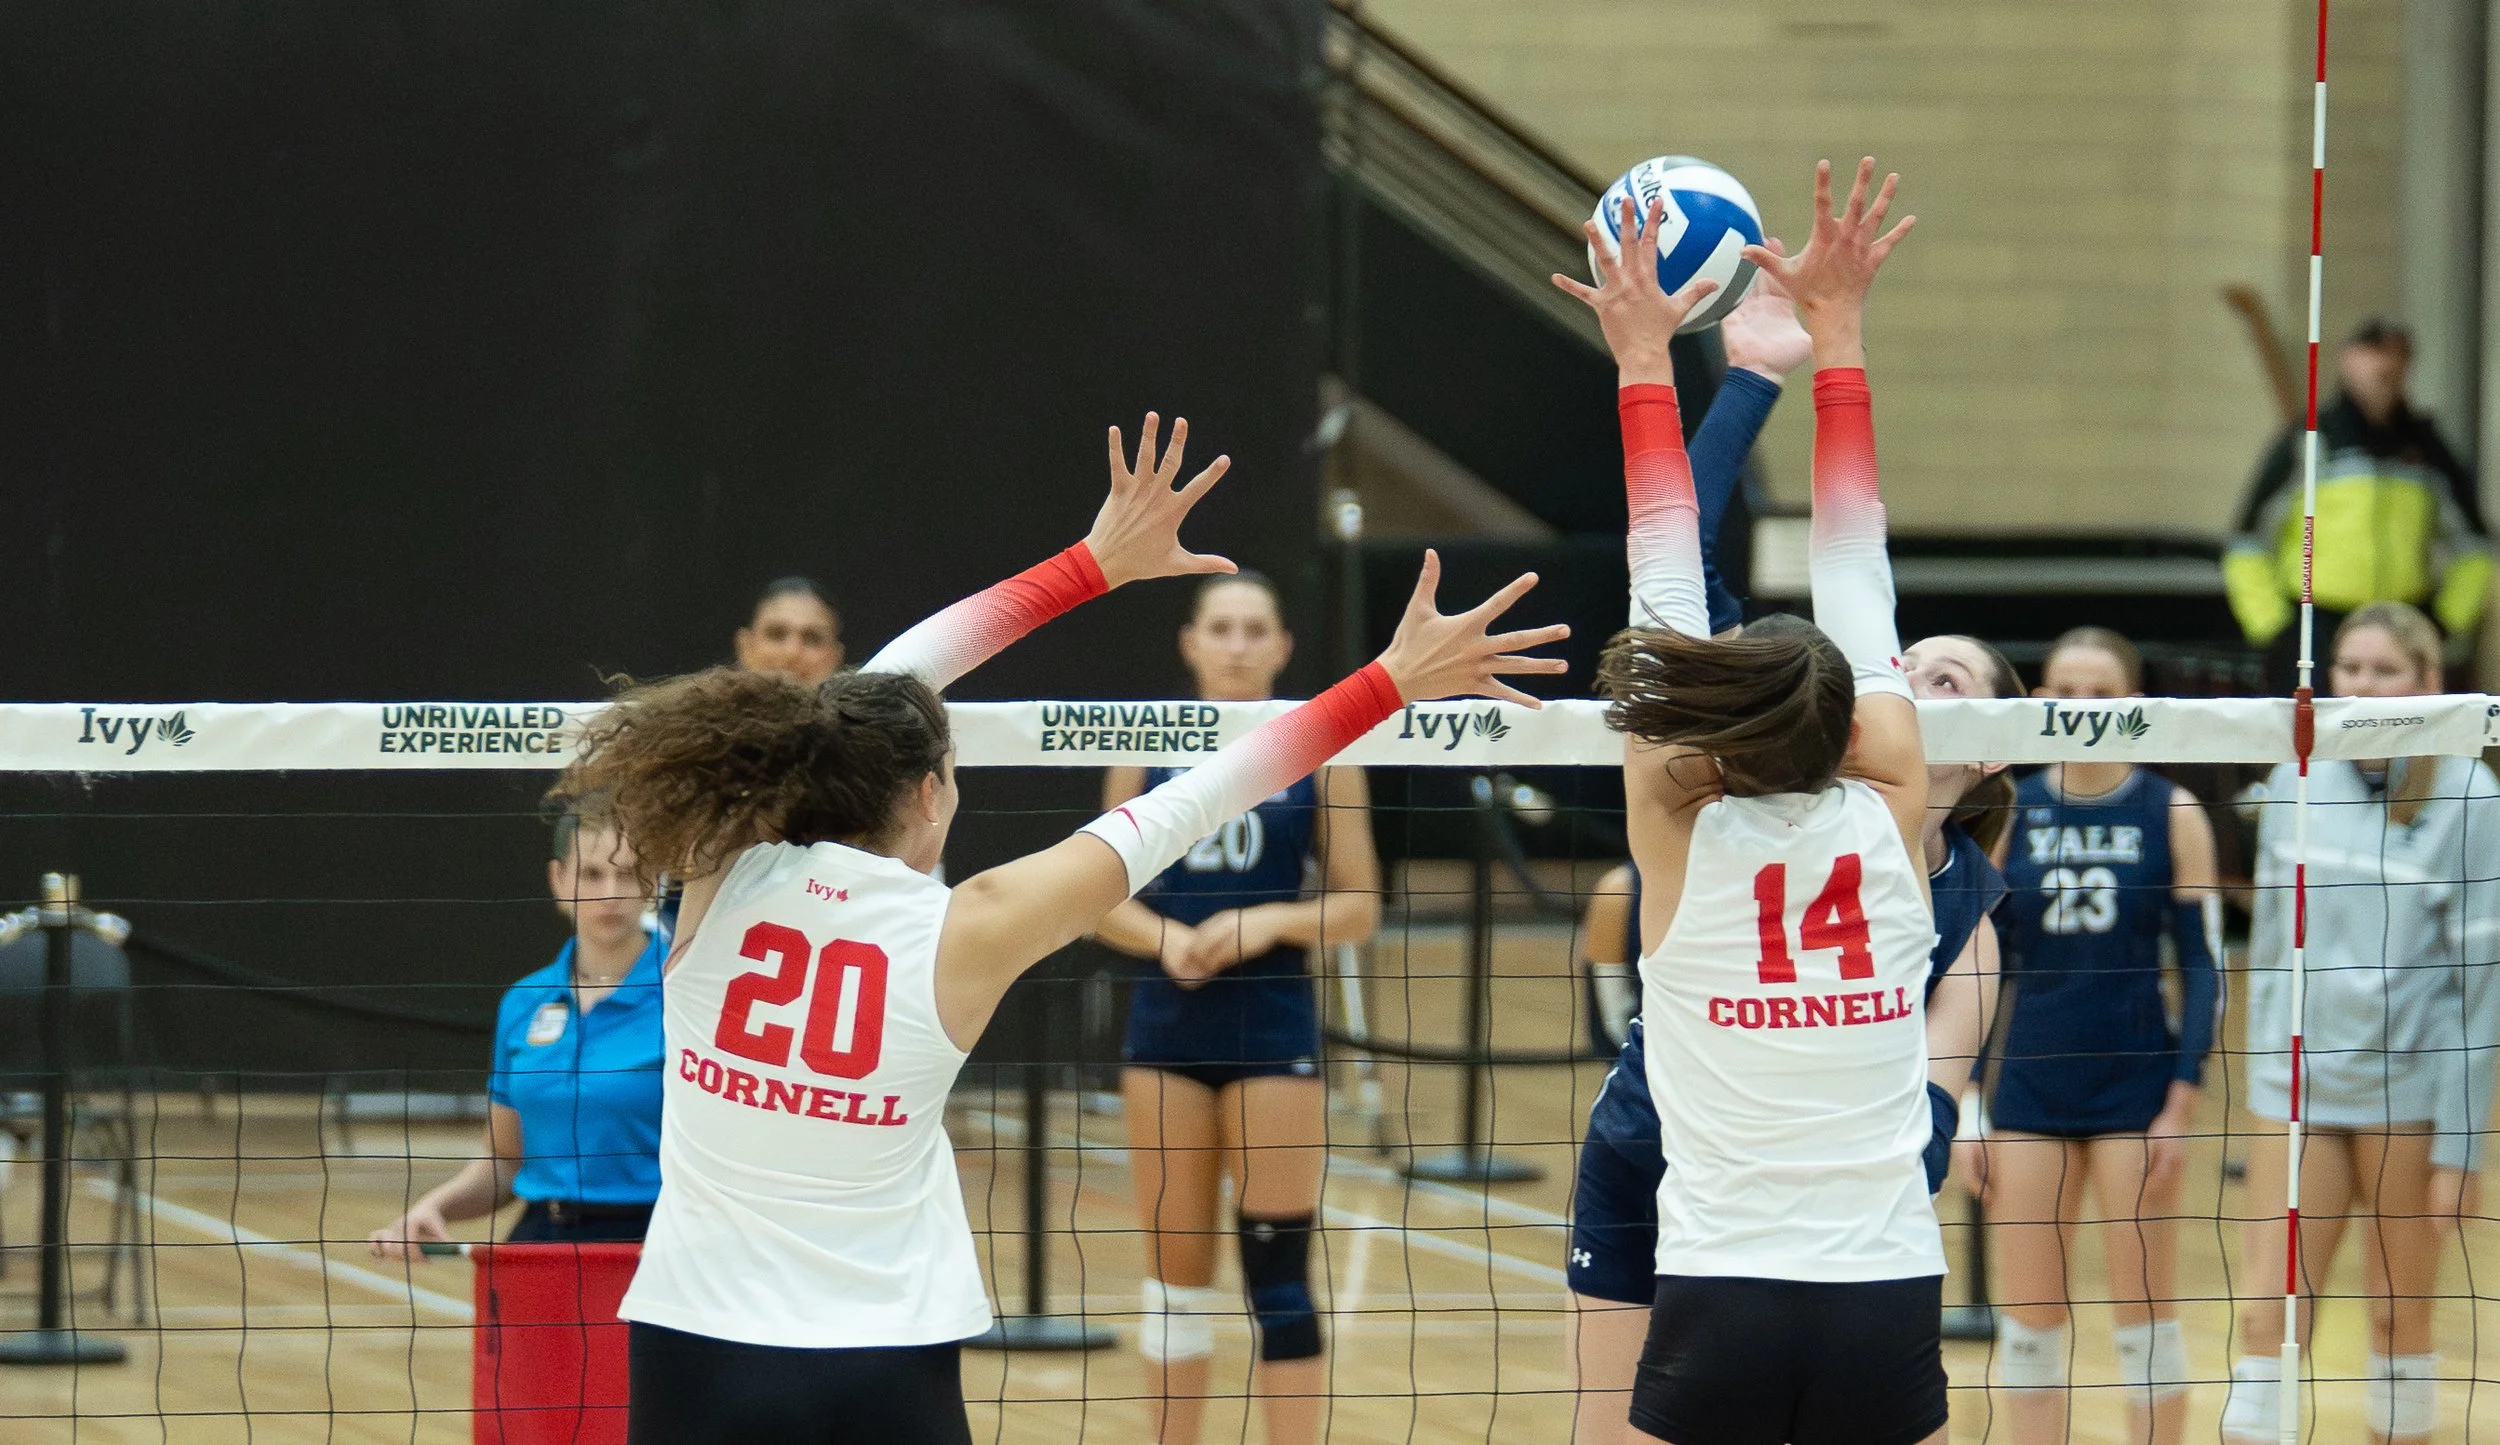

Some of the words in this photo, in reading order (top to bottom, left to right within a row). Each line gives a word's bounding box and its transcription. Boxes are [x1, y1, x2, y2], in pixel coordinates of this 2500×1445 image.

[78, 707, 153, 755] Ivy
[382, 706, 564, 729] UNRIVALED
[1042, 705, 1219, 727] UNRIVALED
[1398, 704, 1470, 750] Ivy
[2040, 701, 2117, 746] Ivy
[380, 731, 563, 753] EXPERIENCE
[1041, 730, 1219, 752] EXPERIENCE
[2027, 826, 2143, 864] YALE
[806, 878, 836, 901] Ivy
[2040, 867, 2119, 935] 23
[1753, 853, 1875, 983] 14
[715, 921, 889, 1079] 20
[1708, 986, 1914, 1029] CORNELL
[680, 1048, 908, 1126] CORNELL
